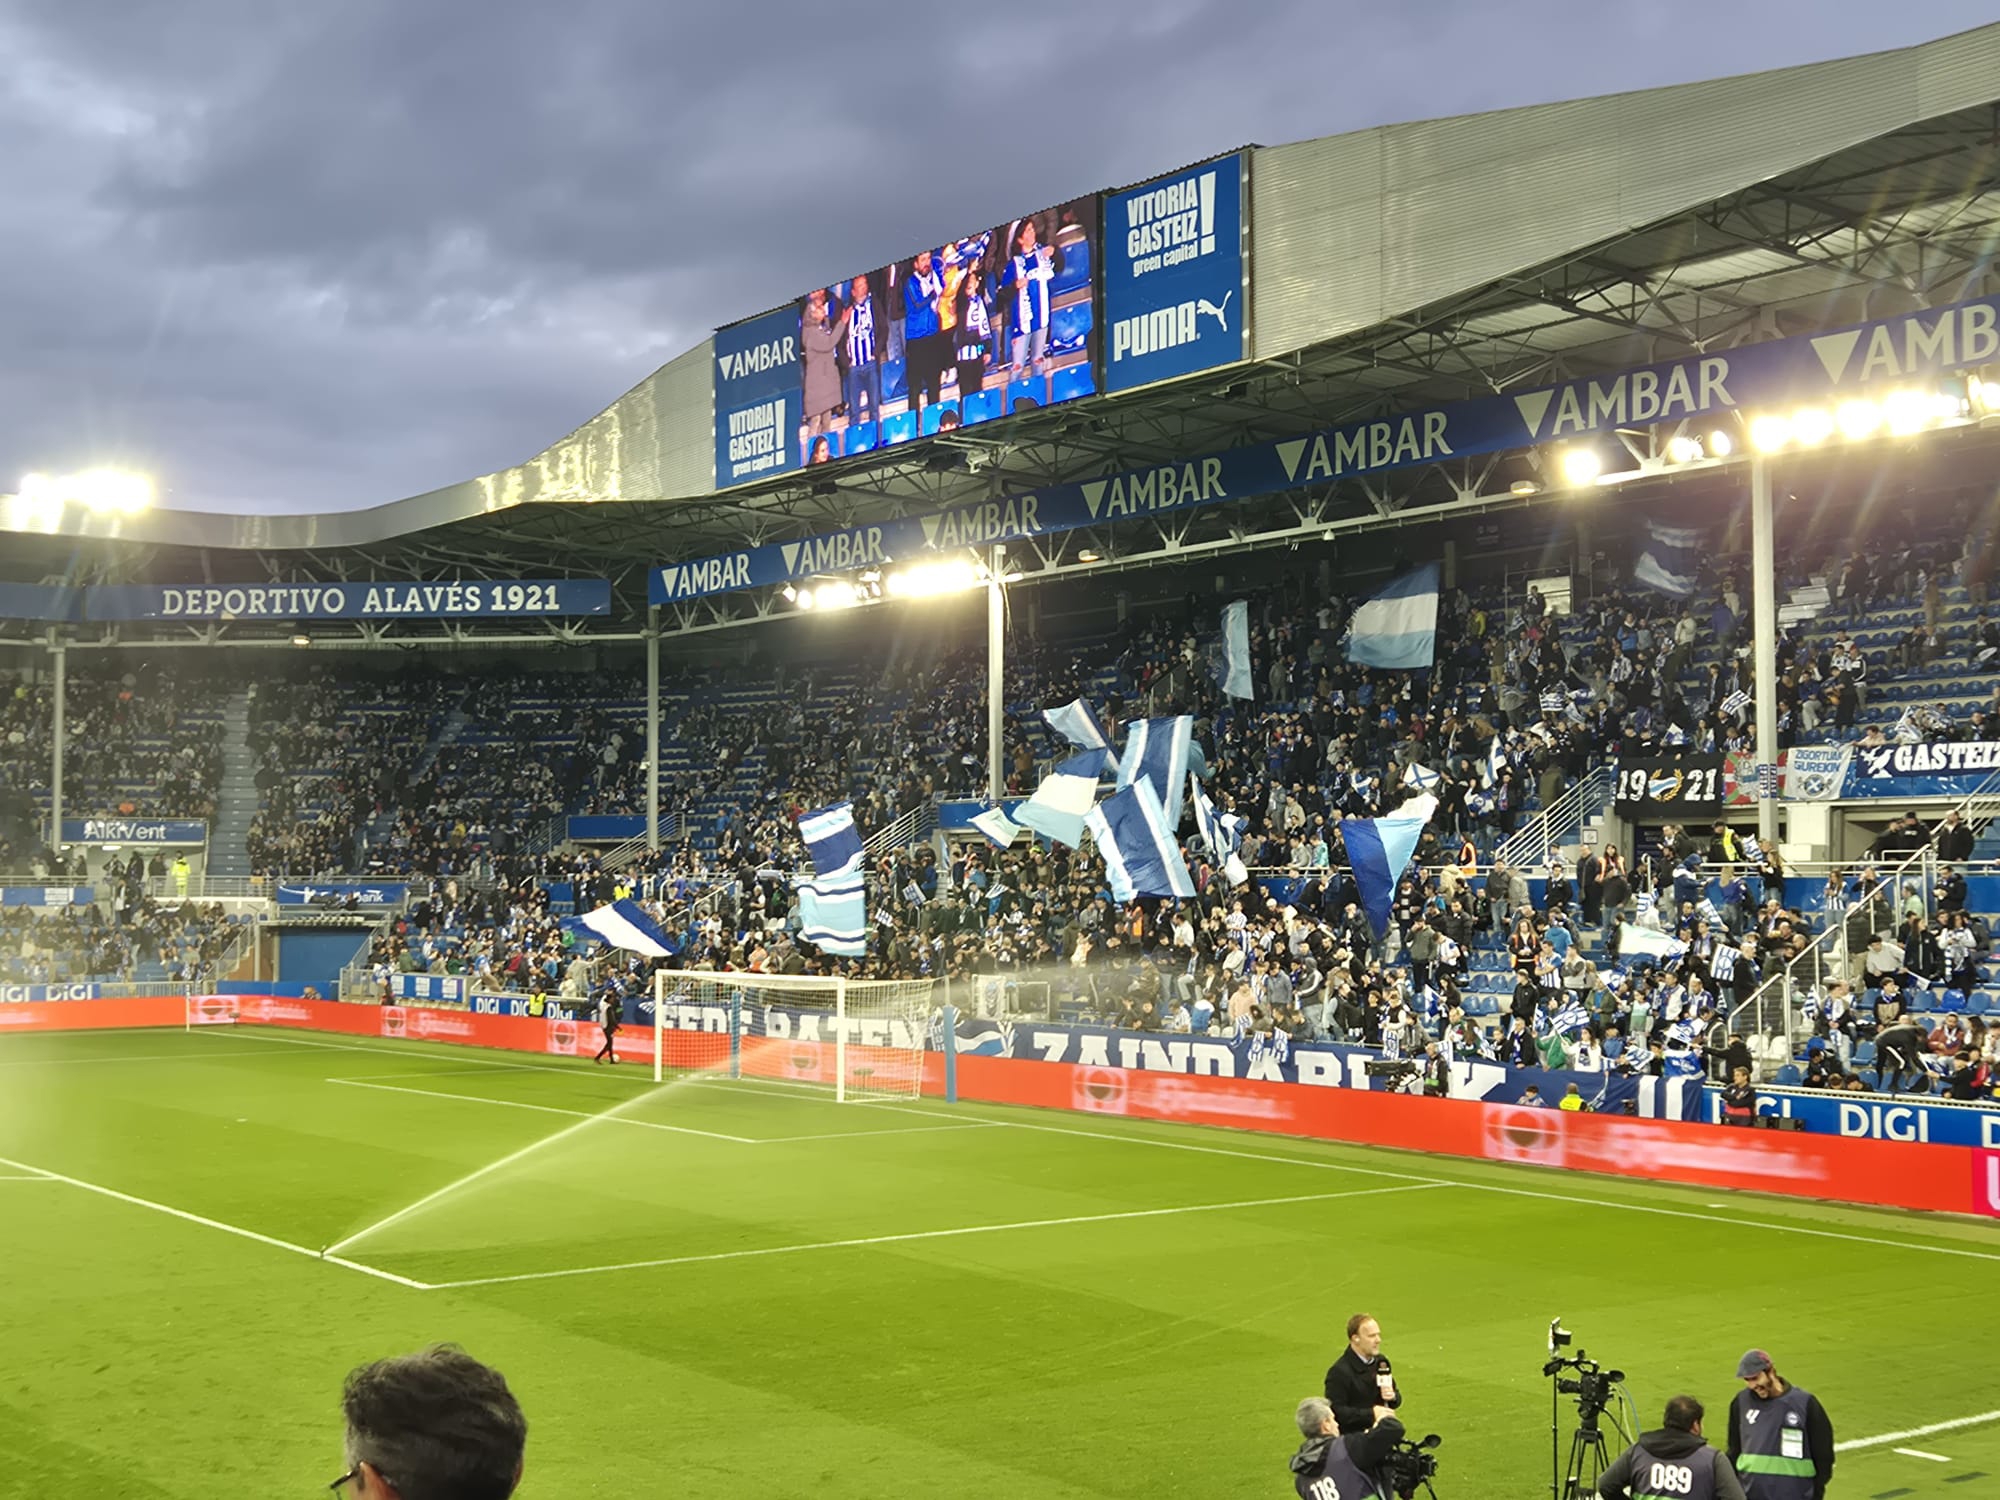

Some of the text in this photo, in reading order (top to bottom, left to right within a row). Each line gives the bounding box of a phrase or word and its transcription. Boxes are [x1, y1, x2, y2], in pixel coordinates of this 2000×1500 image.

[1127, 178, 1198, 228] VITORIA
[1128, 209, 1198, 258] GASTEIZ
[1133, 240, 1198, 277] green capital
[1113, 300, 1196, 361] PUMA
[1859, 303, 2000, 381] AMB
[732, 336, 796, 380] AMBAR
[1552, 356, 1736, 435] AMBAR
[729, 402, 774, 437] VITORIA
[729, 427, 774, 462] GASTEIZ
[1306, 411, 1453, 480] AMBAR
[1106, 457, 1227, 518] AMBAR
[938, 494, 1042, 548] AMBAR
[799, 527, 885, 574] AMBAR
[677, 554, 752, 597] AMBAR
[162, 581, 560, 615] DEPORTIVO ALAVÉS 1921
[1616, 769, 1718, 801] 19 21
[0, 985, 30, 1003] IGI
[476, 997, 500, 1014] DIGI
[1839, 1103, 1929, 1143] DIGI
[1310, 1476, 1340, 1500] 118
[1651, 1462, 1692, 1493] 089
